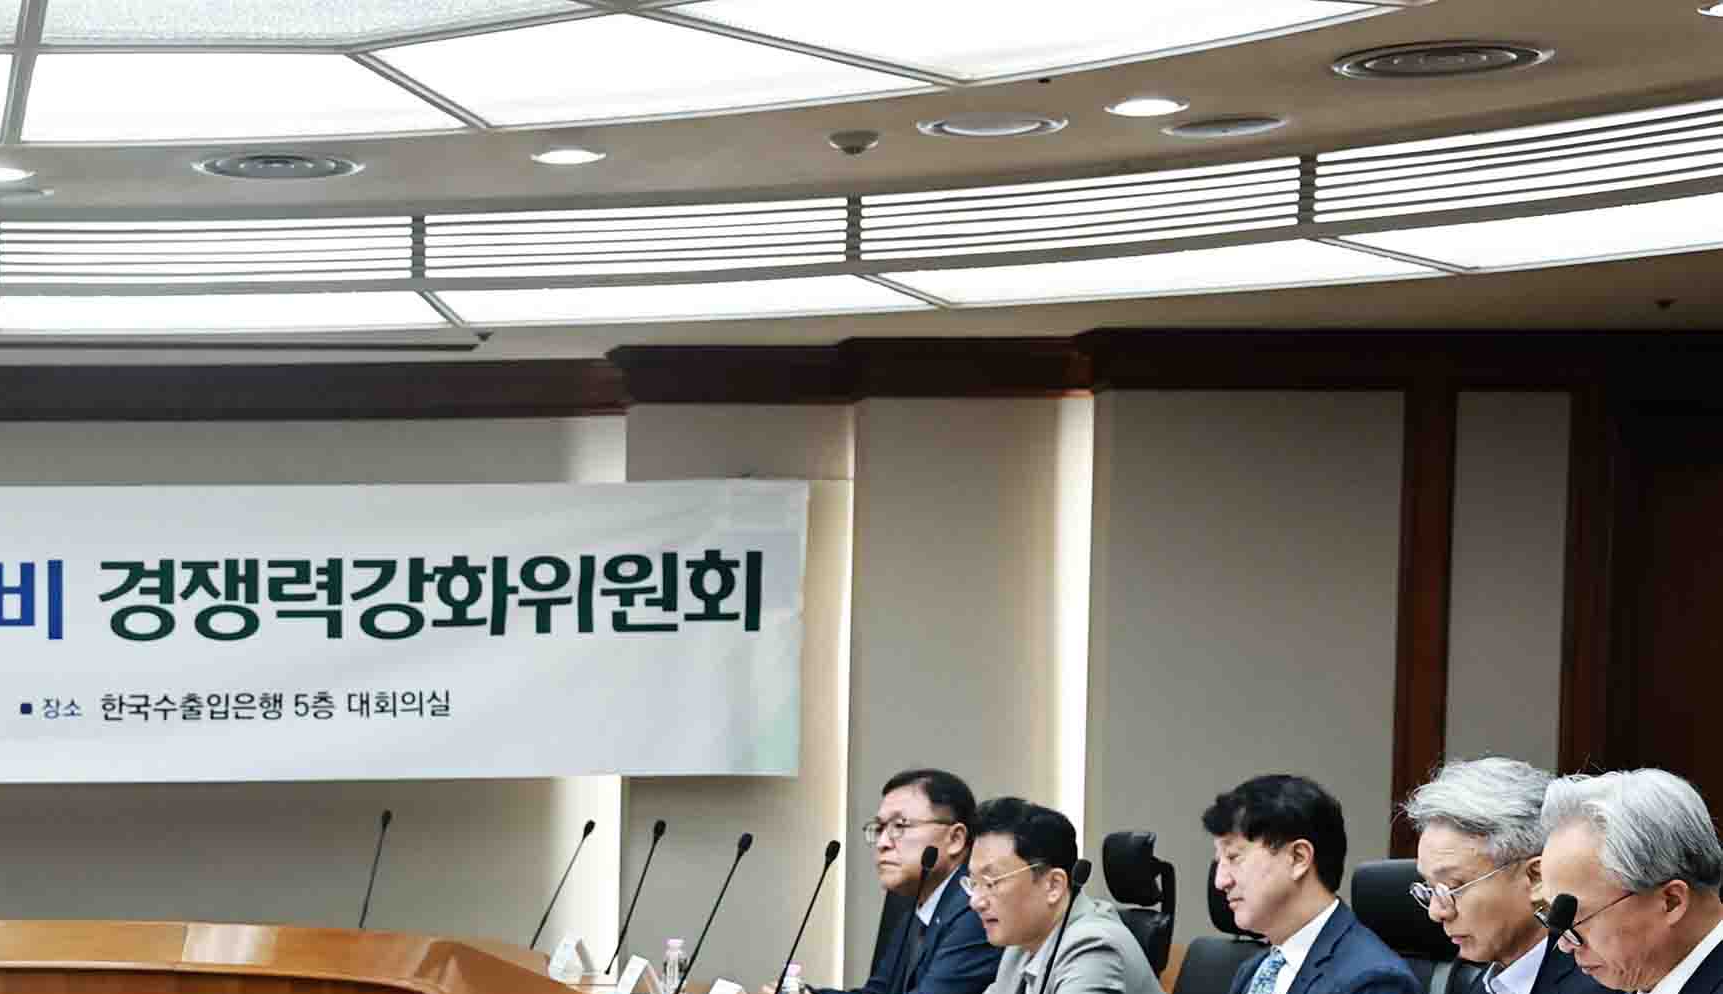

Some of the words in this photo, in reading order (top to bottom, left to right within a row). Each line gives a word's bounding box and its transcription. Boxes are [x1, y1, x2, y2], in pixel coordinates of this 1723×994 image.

[98, 548, 763, 642] 경쟁력강화위원회
[43, 698, 82, 719] 장소
[101, 692, 284, 721] 한국수출입은행
[294, 691, 335, 720] 5층
[347, 690, 450, 718] 대회의실
